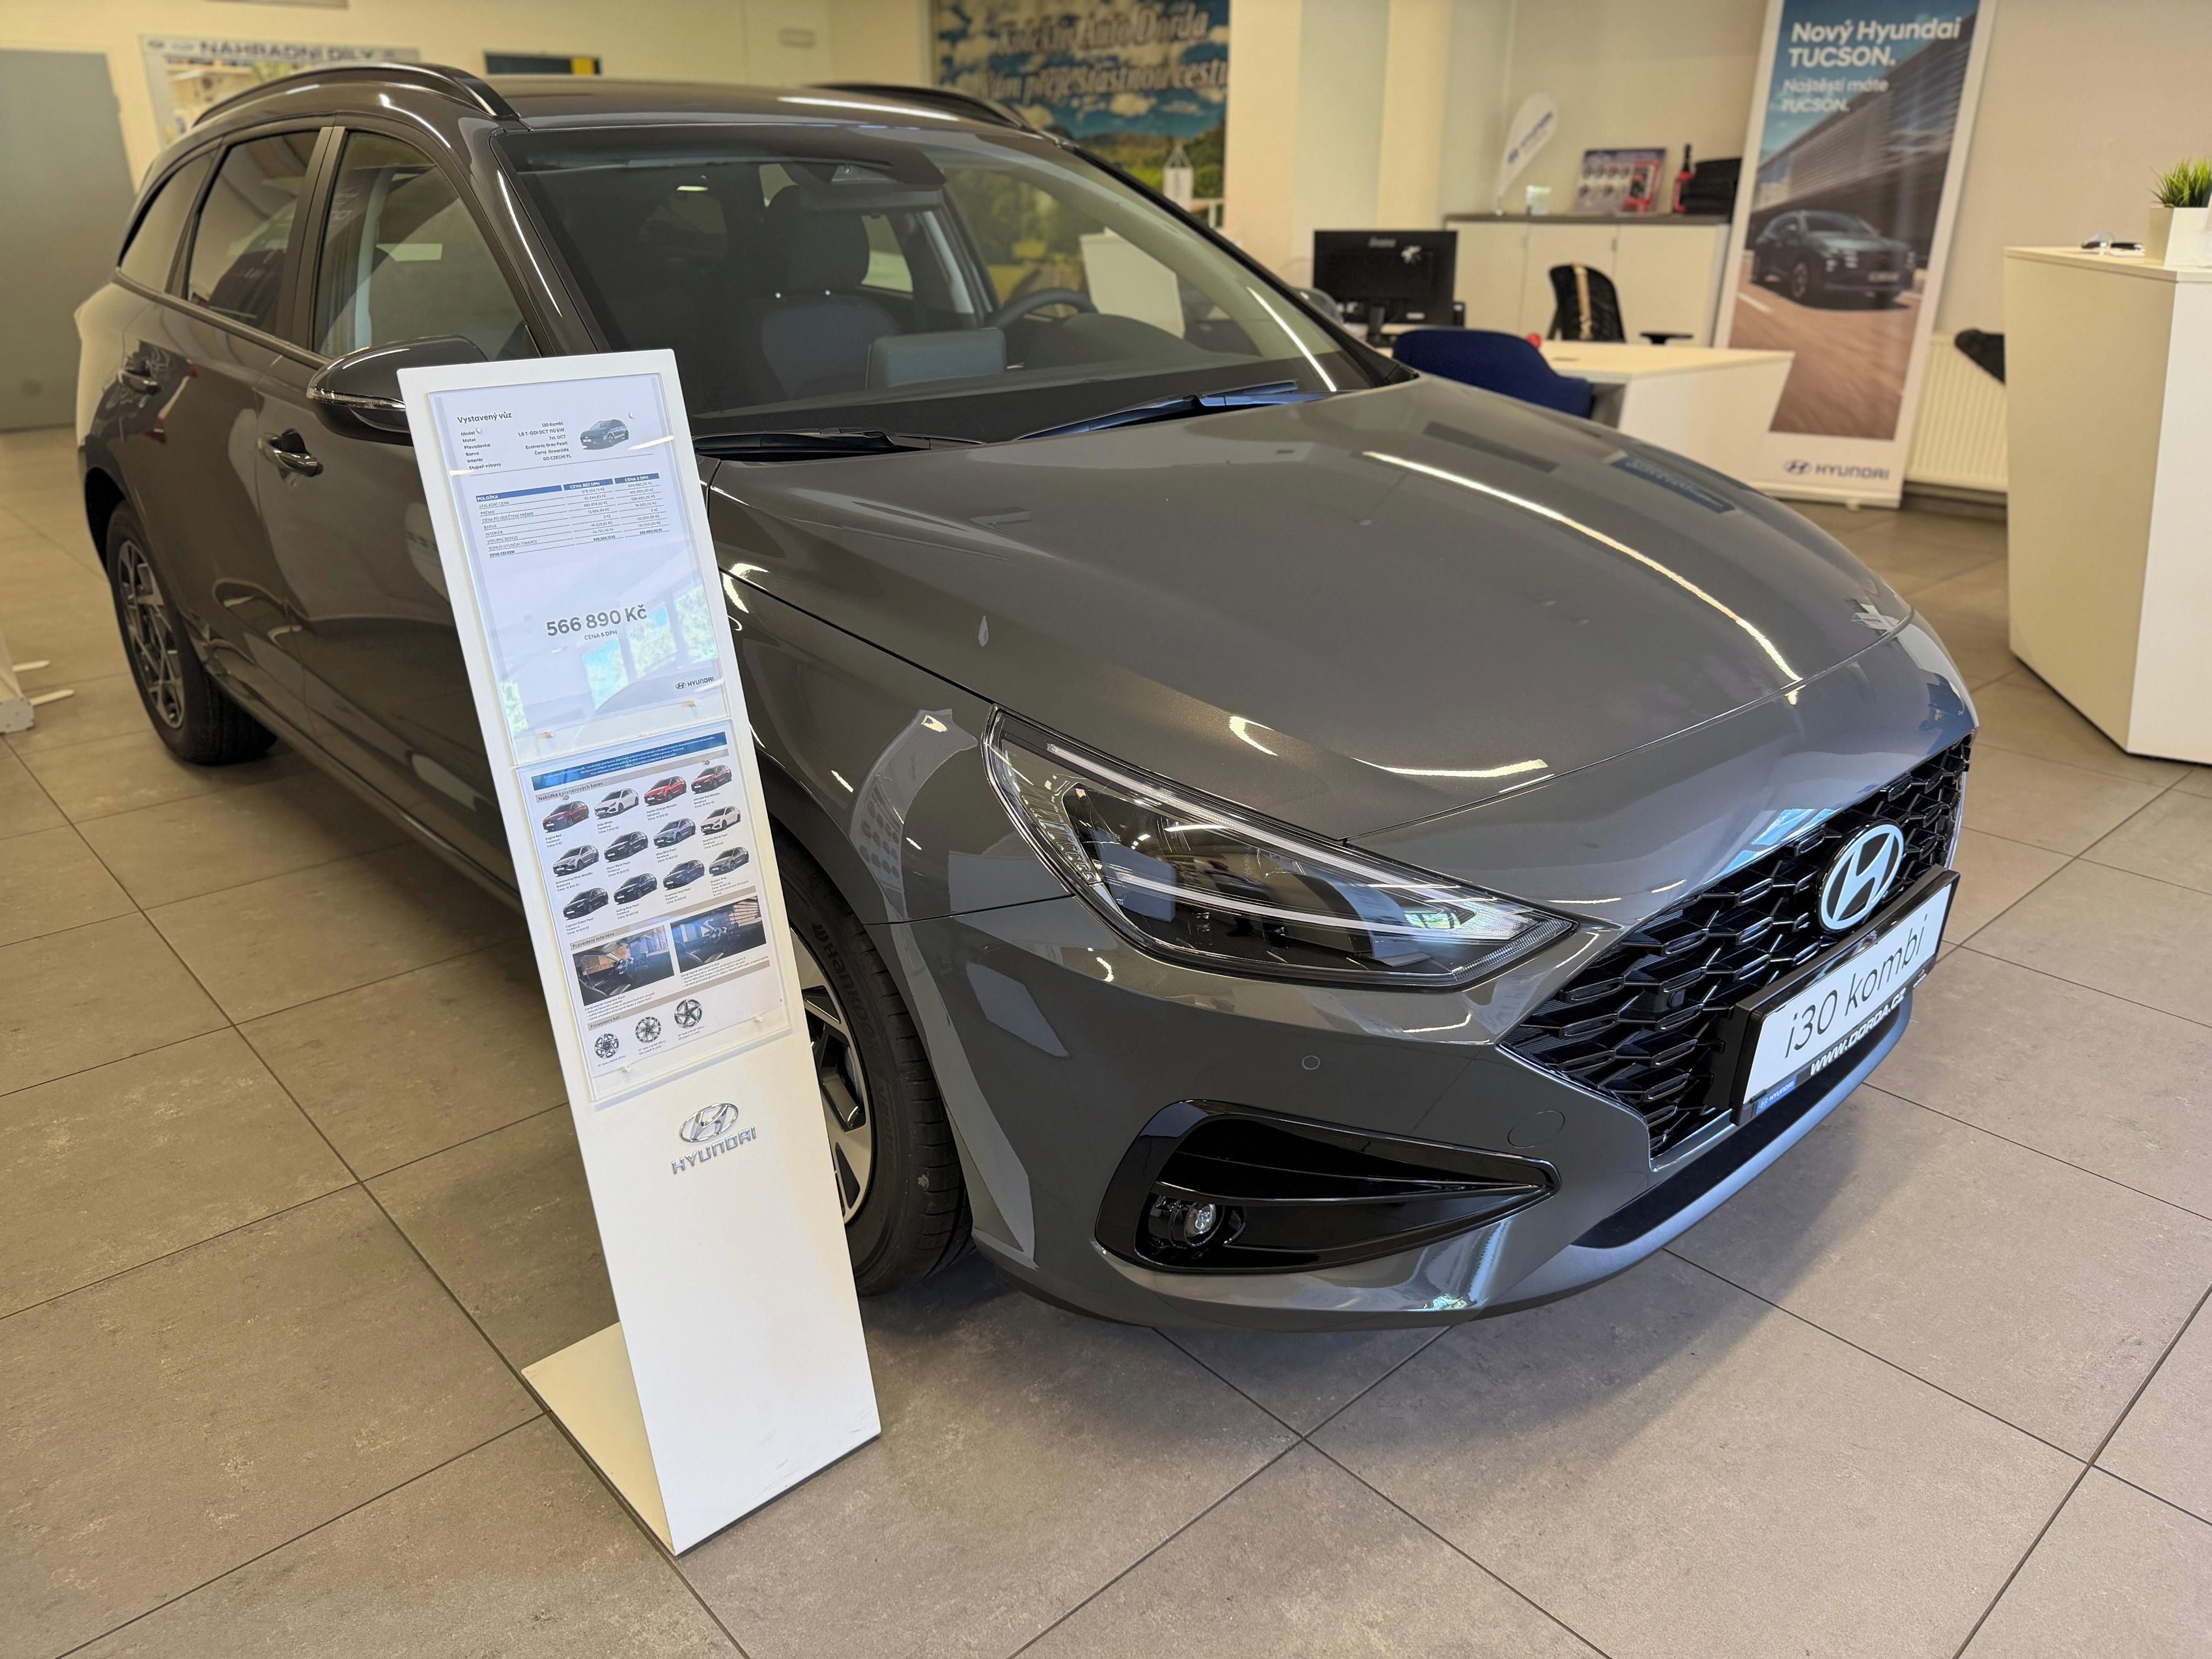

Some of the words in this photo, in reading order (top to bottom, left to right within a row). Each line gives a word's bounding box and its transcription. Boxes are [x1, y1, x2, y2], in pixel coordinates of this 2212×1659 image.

[1791, 19, 1853, 45] Nový
[1856, 17, 1962, 44] Hyundai
[1789, 46, 1896, 68] TUCSON.
[1847, 77, 1889, 92] máte
[1782, 97, 1850, 113] TUCSON.
[457, 413, 497, 423] Vystavený
[1816, 463, 1890, 480] HYUNDAI
[546, 617, 582, 637] 566
[586, 610, 622, 629] 890
[624, 604, 648, 623] Kč
[687, 676, 714, 687] HYUNDAI
[538, 792, 558, 801] Nabídka
[558, 784, 590, 797] exteriérových
[572, 938, 595, 948] Provedení
[596, 932, 615, 941] interiéru
[1784, 989, 1838, 1059] i30
[1844, 913, 1929, 1017] kombi
[590, 1017, 613, 1029] Provedení
[1810, 987, 1906, 1076] WWW.DORDA.CZ
[1769, 1081, 1794, 1101] HYUNDAI
[671, 1125, 757, 1175] HYUNDAI
